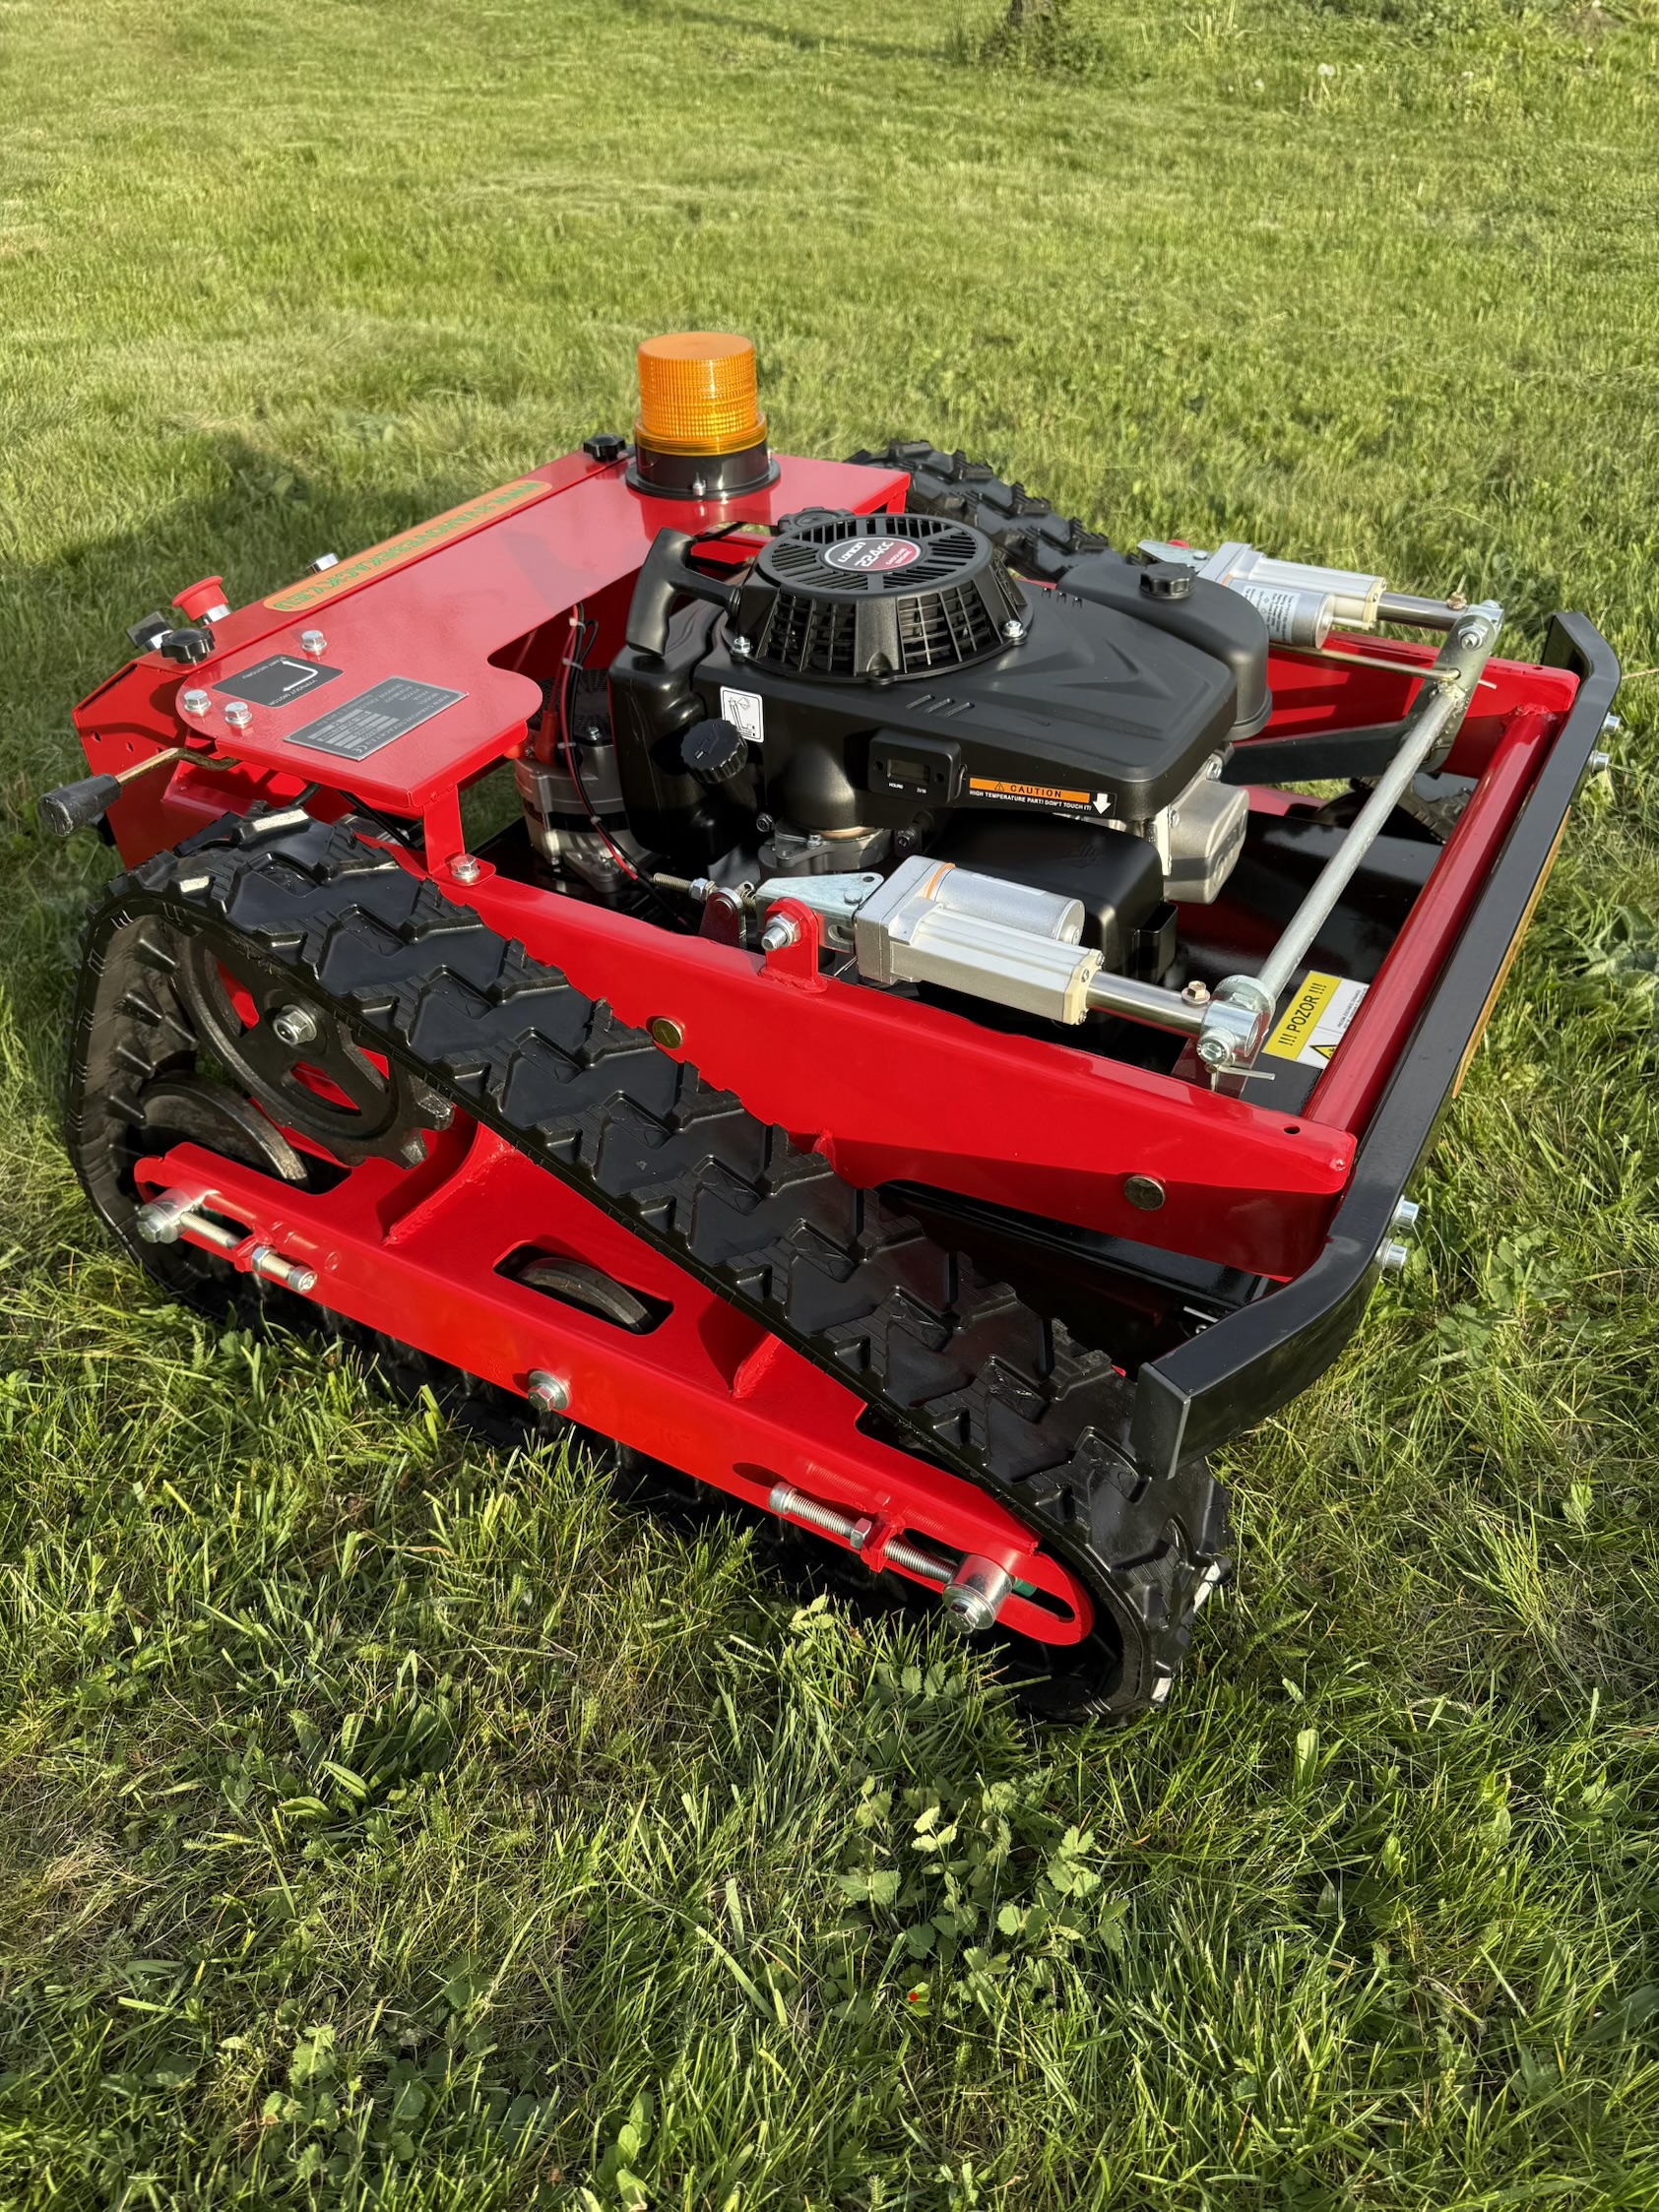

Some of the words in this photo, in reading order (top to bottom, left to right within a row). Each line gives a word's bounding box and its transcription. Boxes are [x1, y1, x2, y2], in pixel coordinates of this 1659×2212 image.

[986, 792, 1026, 803] TEMPERATURE
[1010, 785, 1062, 798] CAUTION
[1286, 994, 1321, 1033] POZOR
